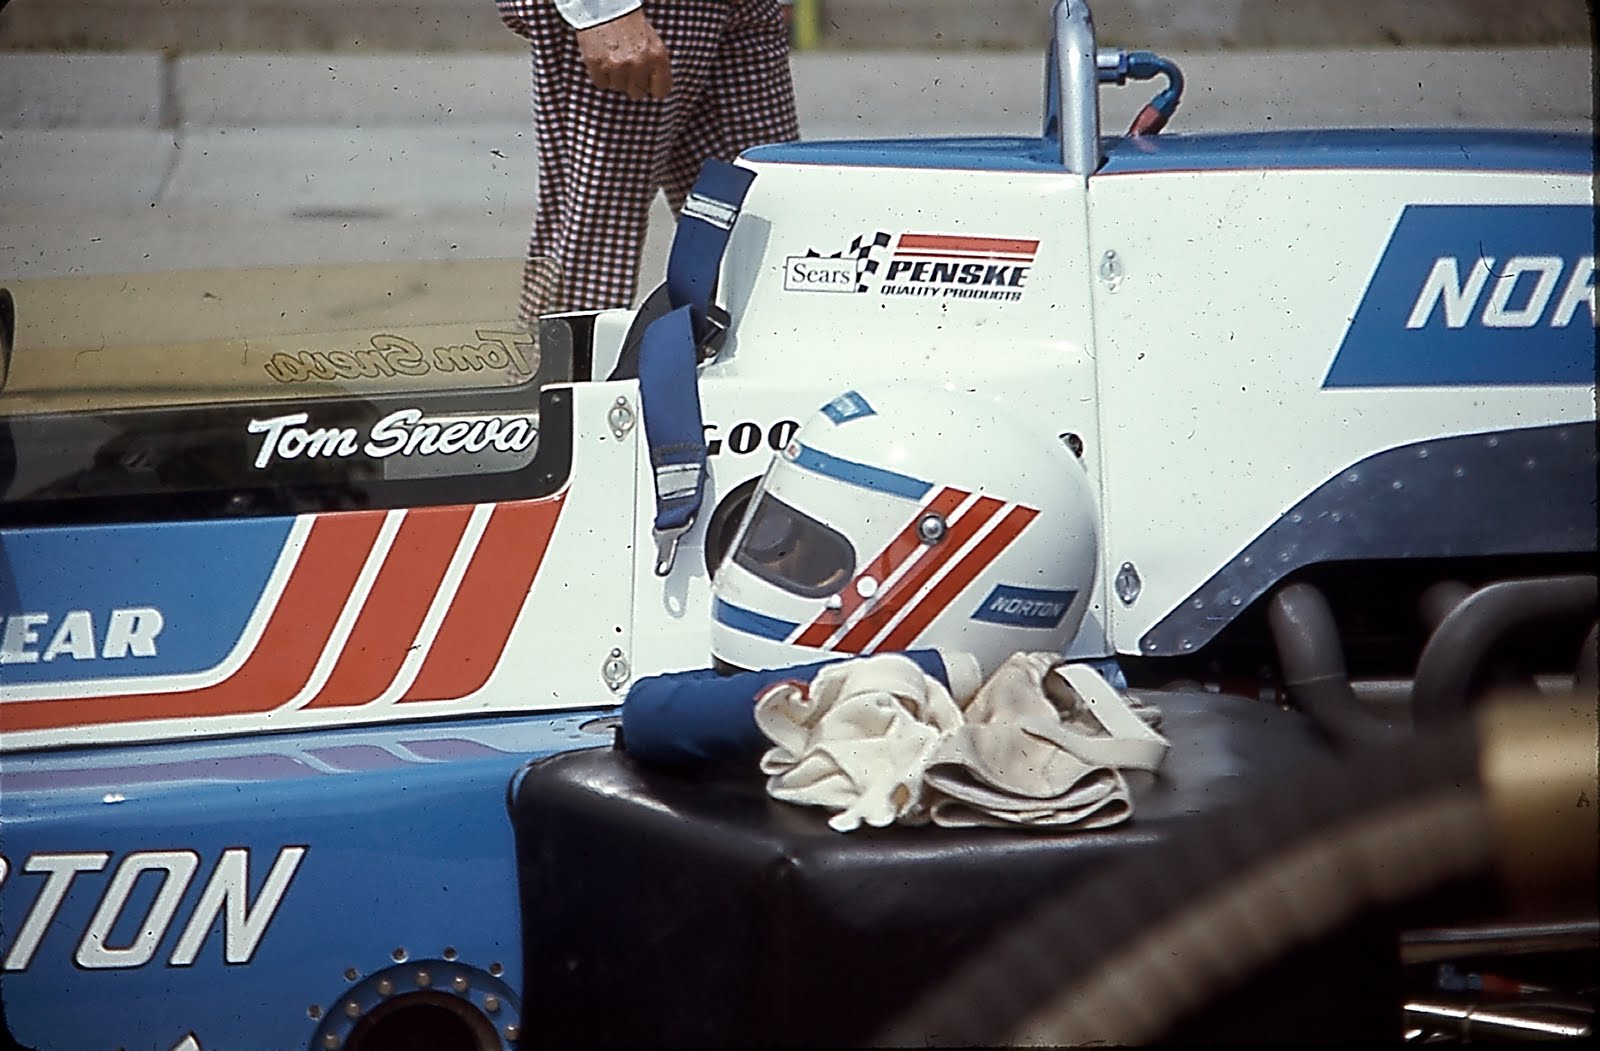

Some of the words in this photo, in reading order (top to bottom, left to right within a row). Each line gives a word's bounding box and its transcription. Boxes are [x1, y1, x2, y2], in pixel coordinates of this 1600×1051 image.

[792, 263, 850, 284] Sears
[885, 260, 1030, 287] PENSKE
[880, 284, 940, 298] QUALITY
[942, 286, 1022, 301] PRODUCTS
[248, 412, 358, 469] Tom
[364, 409, 538, 459] Sneva
[990, 597, 1066, 617] NORTON
[0, 607, 163, 663] EAR
[0, 846, 306, 971] TON
